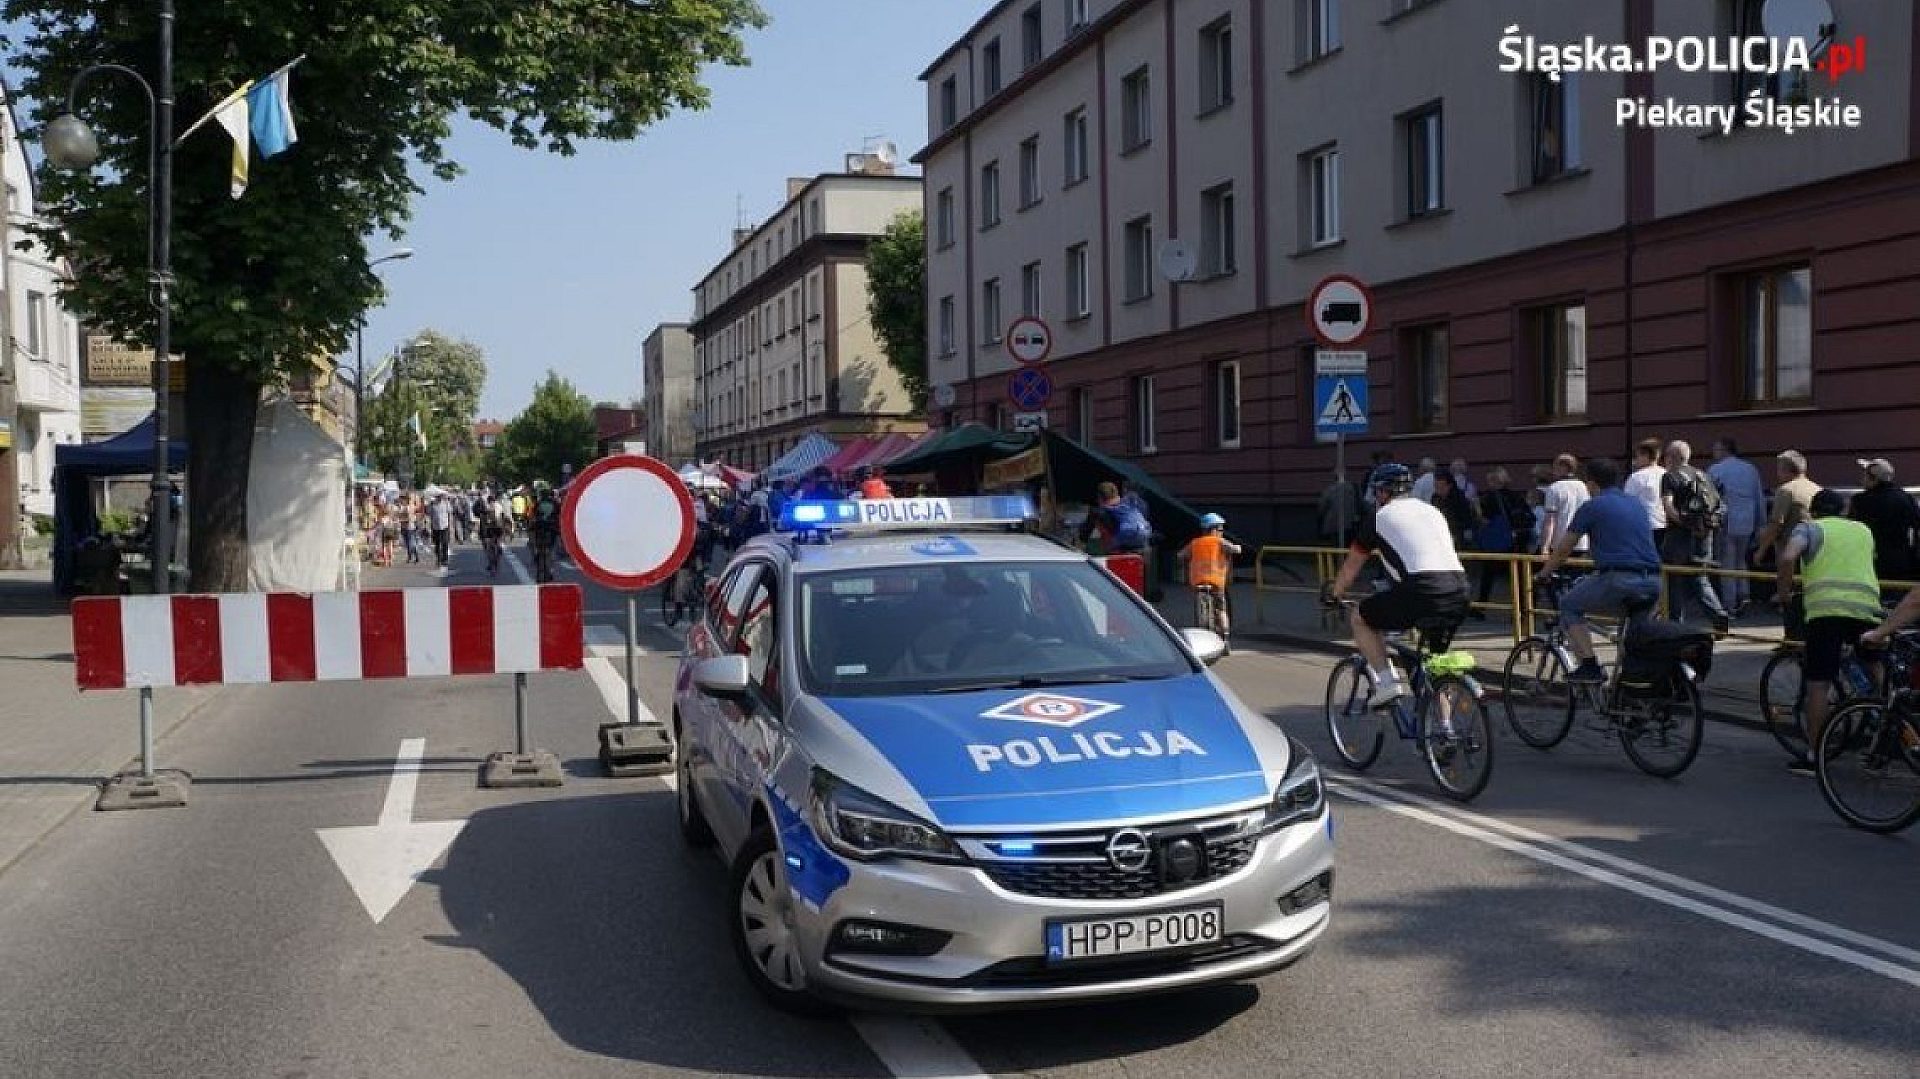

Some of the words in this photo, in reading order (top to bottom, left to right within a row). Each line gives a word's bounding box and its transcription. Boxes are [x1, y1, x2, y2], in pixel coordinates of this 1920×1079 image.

[867, 502, 946, 522] POLICJA
[966, 730, 1207, 772] POLICJA
[1068, 920, 1135, 956] HPP
[1146, 911, 1217, 947] P008
